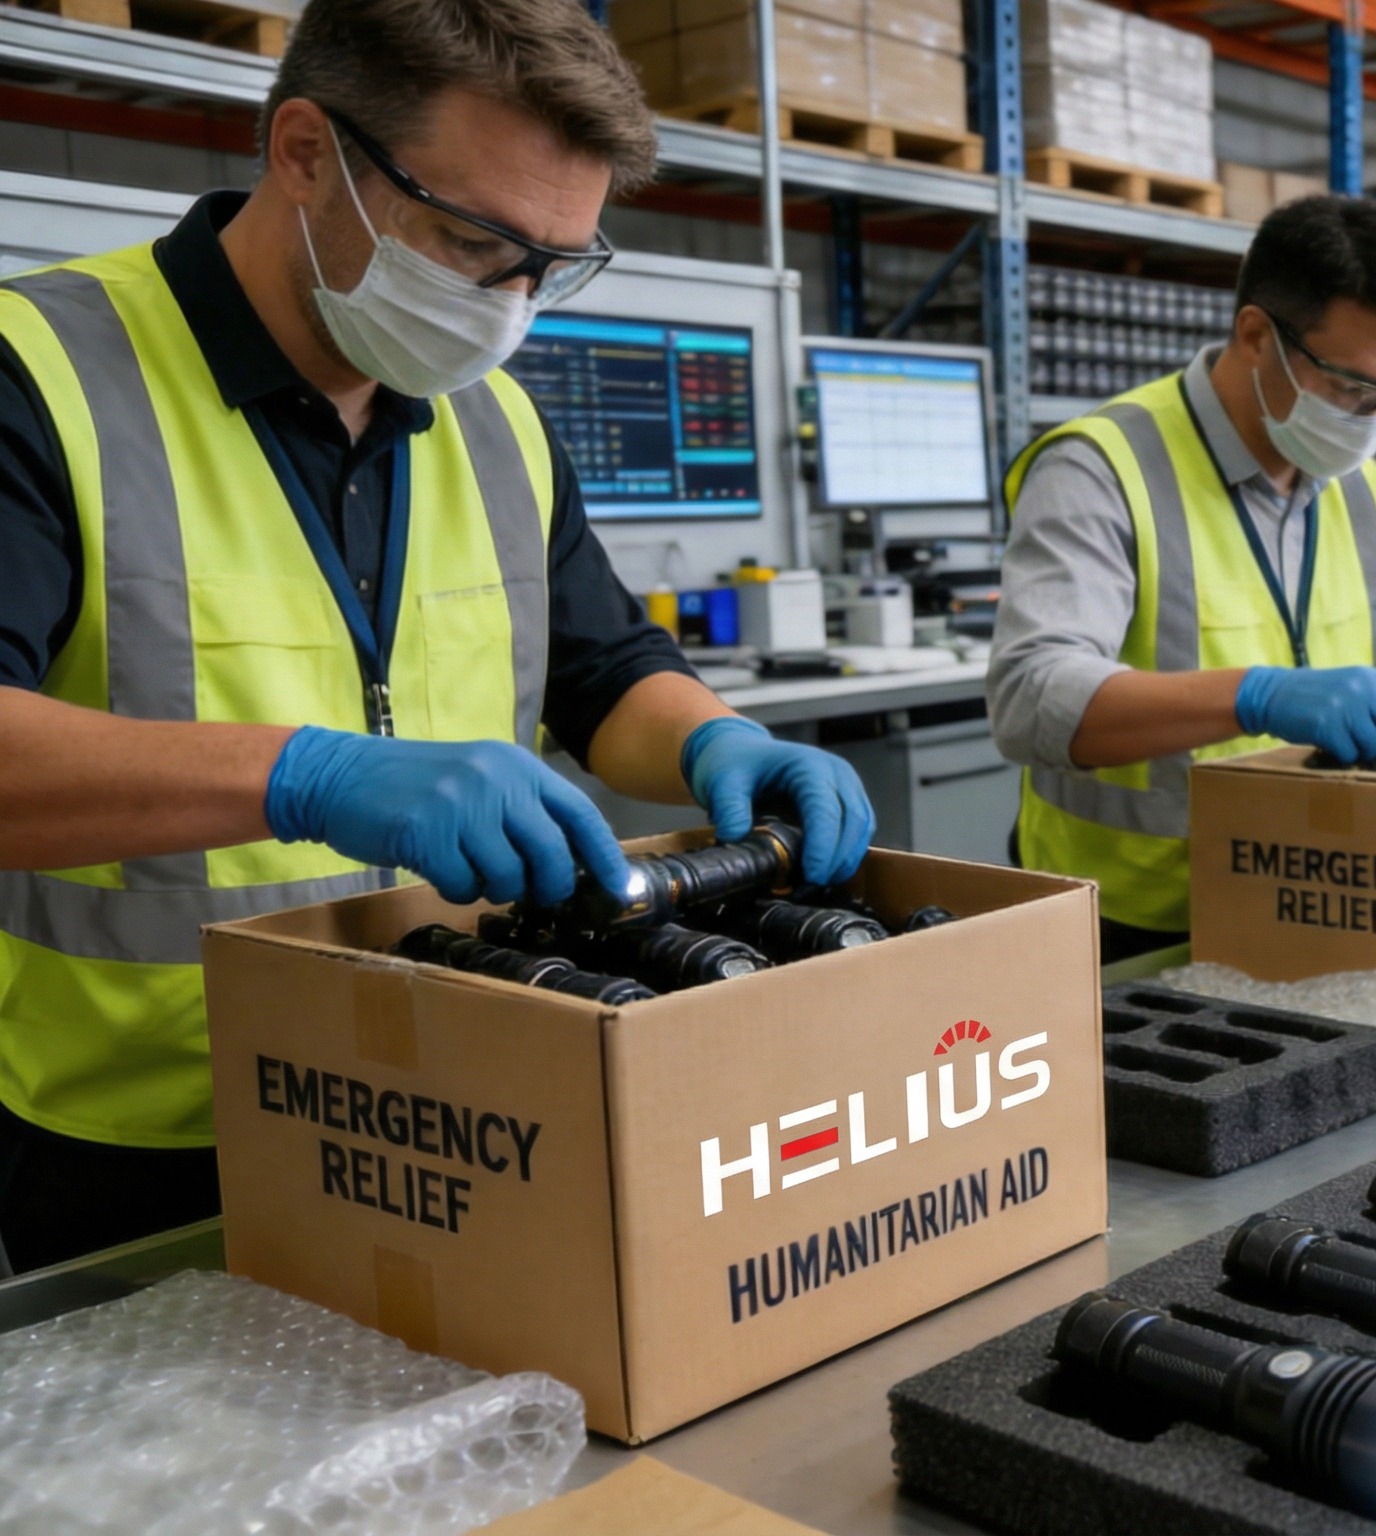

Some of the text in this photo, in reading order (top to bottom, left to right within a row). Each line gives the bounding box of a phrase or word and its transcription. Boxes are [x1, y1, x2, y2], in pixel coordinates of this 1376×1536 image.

[256, 1054, 542, 1183] EMERGENCY
[319, 1138, 472, 1234] RELIEF
[700, 1030, 1051, 1218] HELIUS
[727, 1146, 1049, 1324] HUMANITARIAN AID
